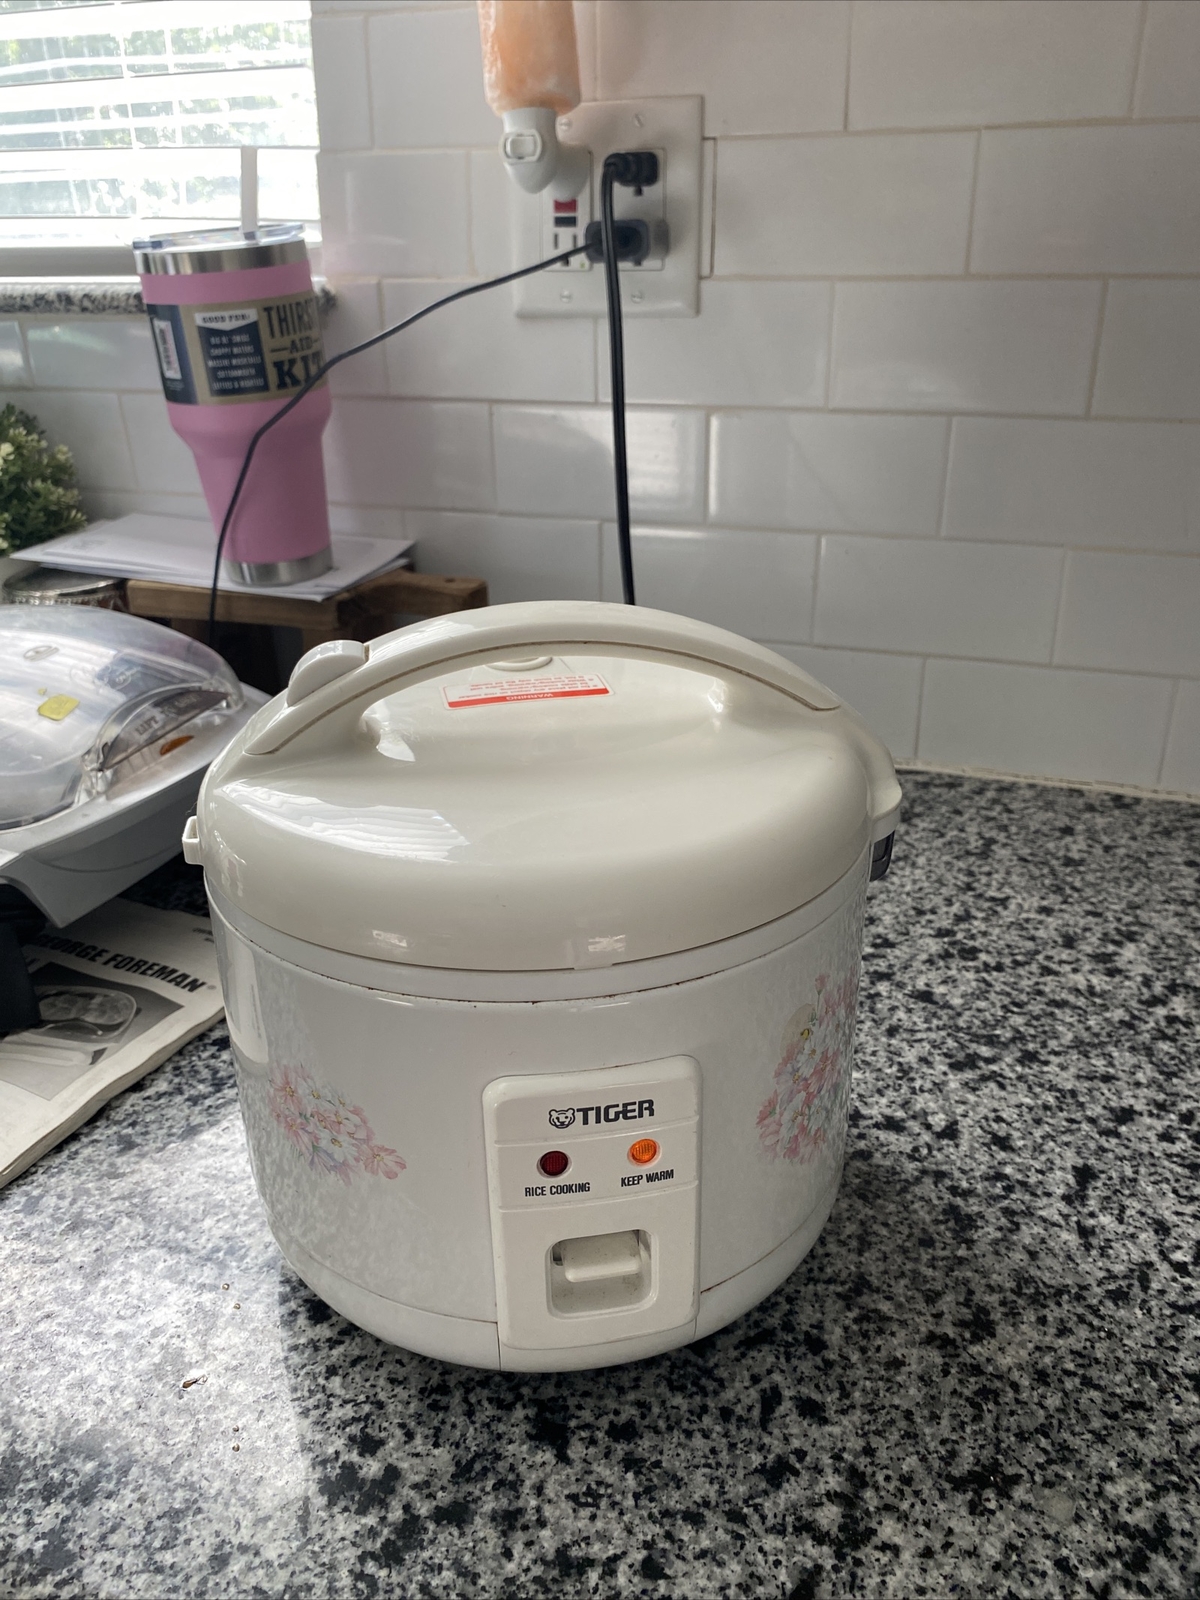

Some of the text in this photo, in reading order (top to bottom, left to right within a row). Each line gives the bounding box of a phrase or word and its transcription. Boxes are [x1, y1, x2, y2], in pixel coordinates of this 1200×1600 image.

[290, 335, 313, 354] AID
[506, 693, 554, 701] WARNING
[103, 954, 207, 994] FOREMAN
[576, 1099, 655, 1126] TIGER
[620, 1169, 674, 1188] KEEP WARM
[524, 1182, 591, 1197] RICE COOKING
